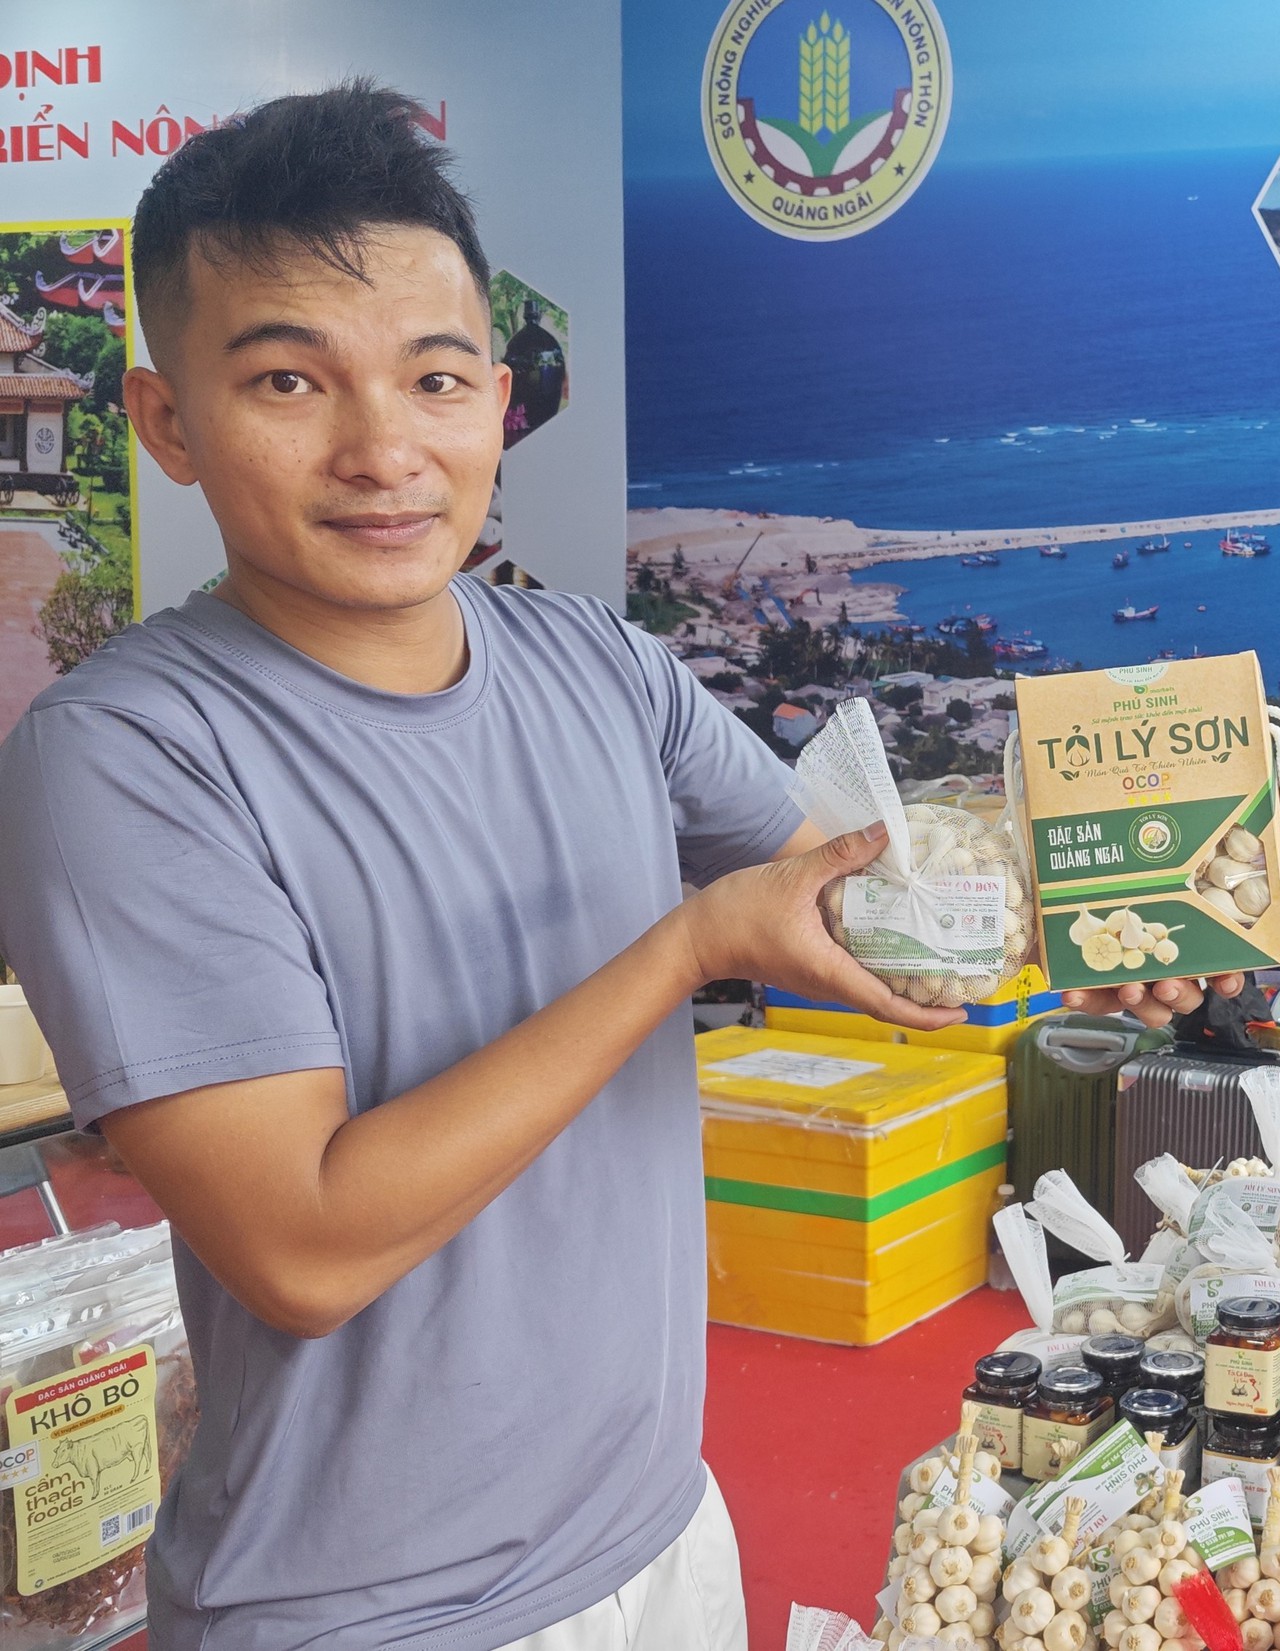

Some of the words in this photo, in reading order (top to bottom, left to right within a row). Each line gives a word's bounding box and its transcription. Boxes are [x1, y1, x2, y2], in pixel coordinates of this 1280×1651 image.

[0, 104, 89, 163] IỂN
[772, 196, 829, 221] QUẢNG
[833, 191, 874, 219] NGÃI
[1113, 696, 1141, 712] PHÚ
[1146, 694, 1178, 708] SINH
[1037, 724, 1103, 769] TỎI
[1114, 719, 1157, 762] LÝ
[1168, 715, 1250, 755] SƠN
[1122, 773, 1170, 790] OCOP
[1047, 825, 1073, 848] ĐẶC
[1076, 820, 1102, 843] SẢN
[1050, 846, 1091, 871] QUẢNG
[1095, 843, 1125, 866] NGÃI
[38, 1389, 56, 1402] ĐẶC
[58, 1382, 75, 1393] SẢN
[78, 1371, 106, 1387] QUẢNG
[108, 1363, 127, 1376] NGÃI
[30, 1392, 92, 1435] KHÔ
[103, 1373, 140, 1407] BÒ
[0, 1448, 35, 1468] COP
[1128, 1454, 1147, 1474] PHÚ
[25, 1472, 71, 1498] cẩm
[26, 1480, 86, 1511] thạch
[1105, 1471, 1127, 1492] SINH
[27, 1495, 84, 1527] foods
[1189, 1515, 1210, 1533] PHÚ
[1210, 1508, 1232, 1522] SINH
[1016, 1533, 1030, 1553] SINH
